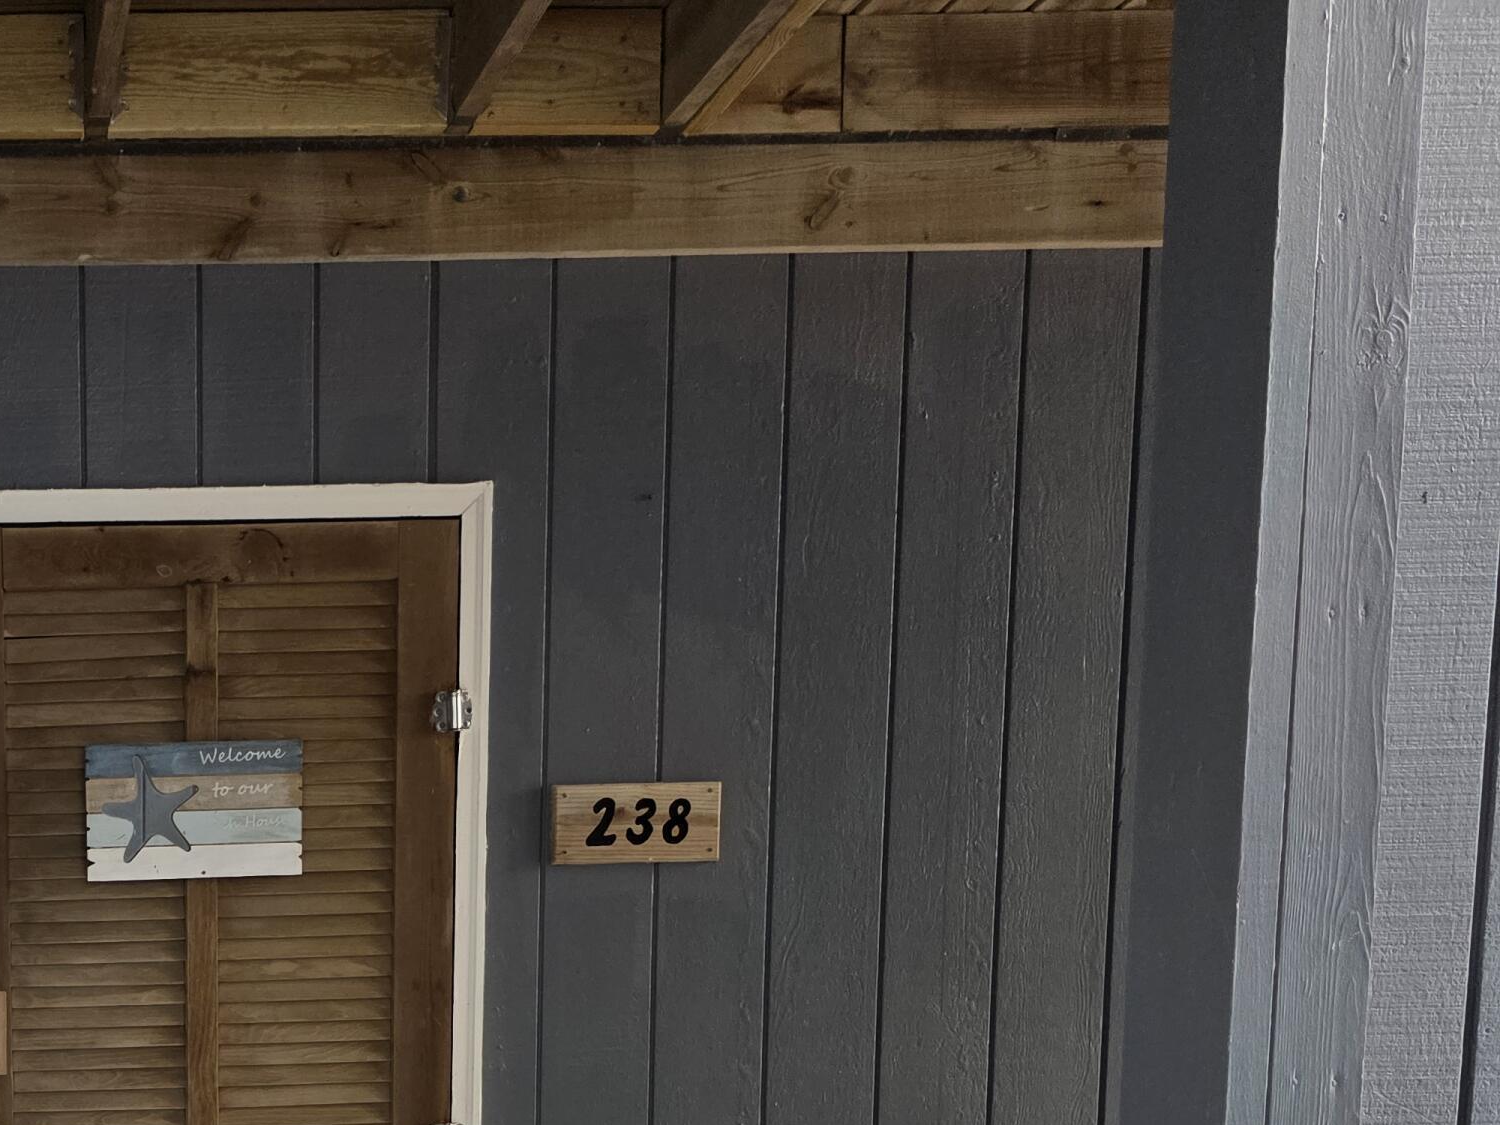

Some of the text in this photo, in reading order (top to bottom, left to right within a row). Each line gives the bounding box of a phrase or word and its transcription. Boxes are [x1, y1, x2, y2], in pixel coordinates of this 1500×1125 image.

[199, 747, 286, 766] Welcome
[211, 781, 274, 798] to our
[585, 797, 692, 847] 238
